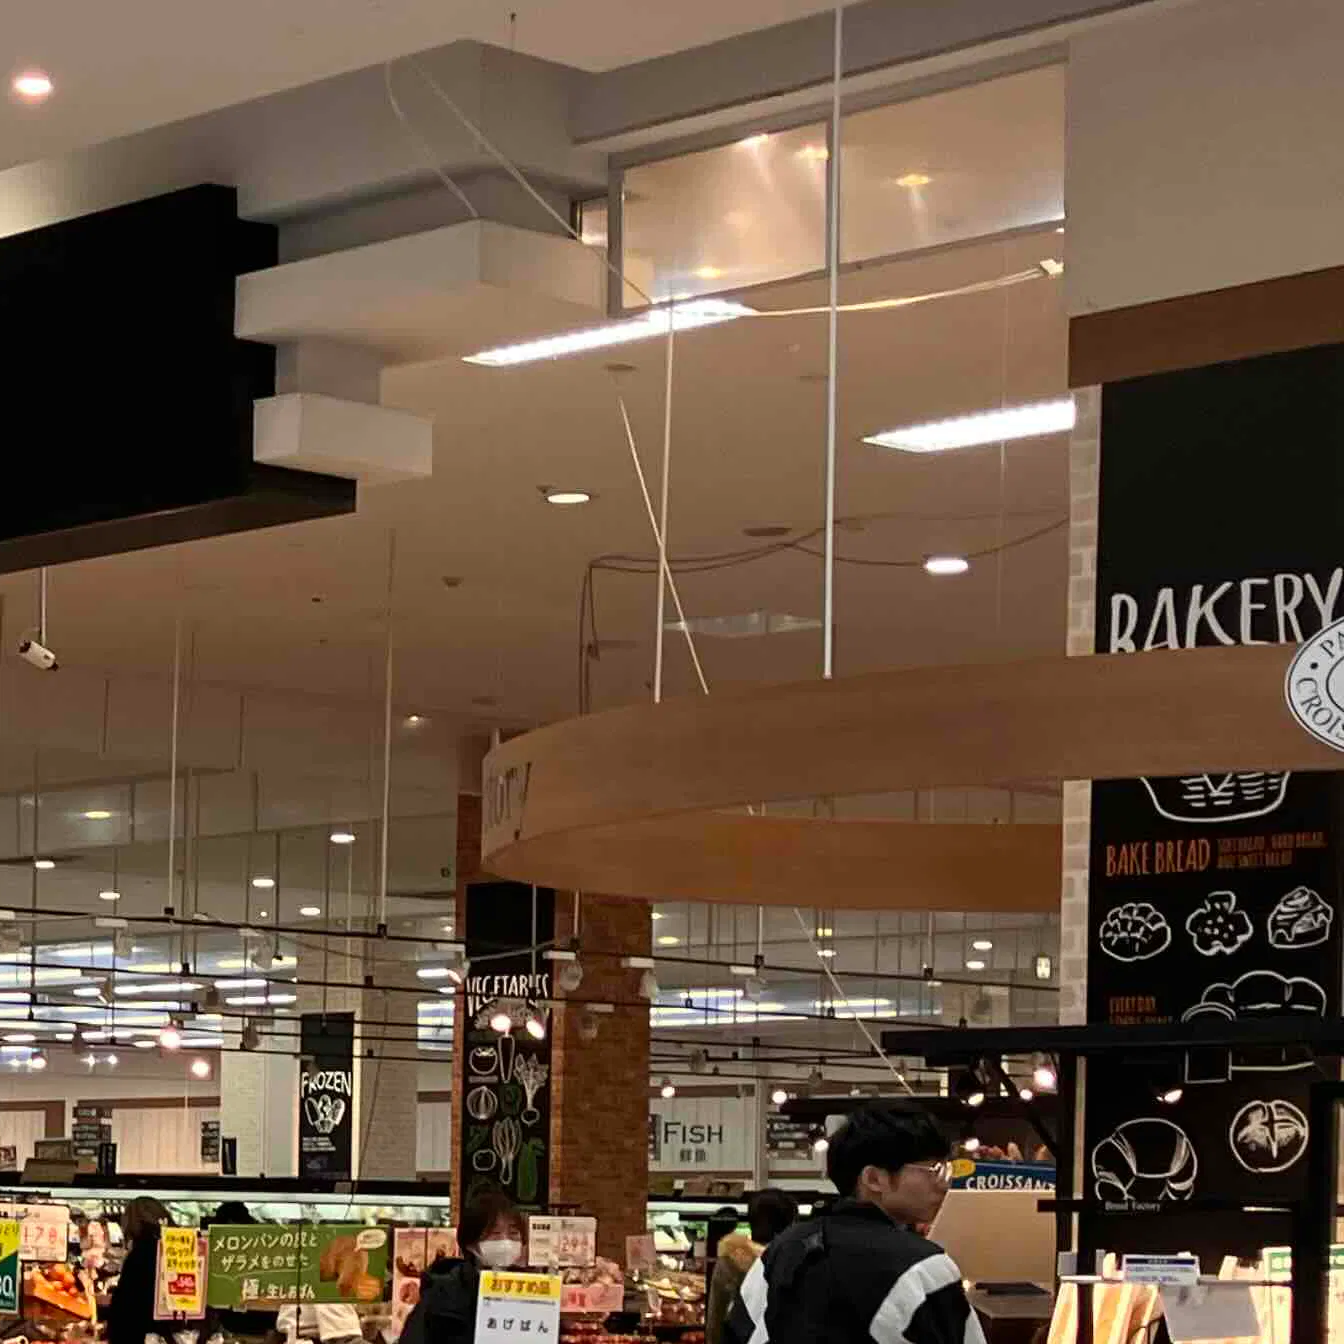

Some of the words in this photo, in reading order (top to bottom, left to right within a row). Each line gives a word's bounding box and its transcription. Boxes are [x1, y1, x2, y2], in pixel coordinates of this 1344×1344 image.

[1110, 566, 1344, 654] BAKERY
[1106, 839, 1152, 877] BAKE
[1154, 837, 1211, 874] BREAD
[301, 1070, 352, 1099] FROZEN
[664, 1122, 724, 1145] FISH
[490, 1279, 551, 1295] おすすめ品
